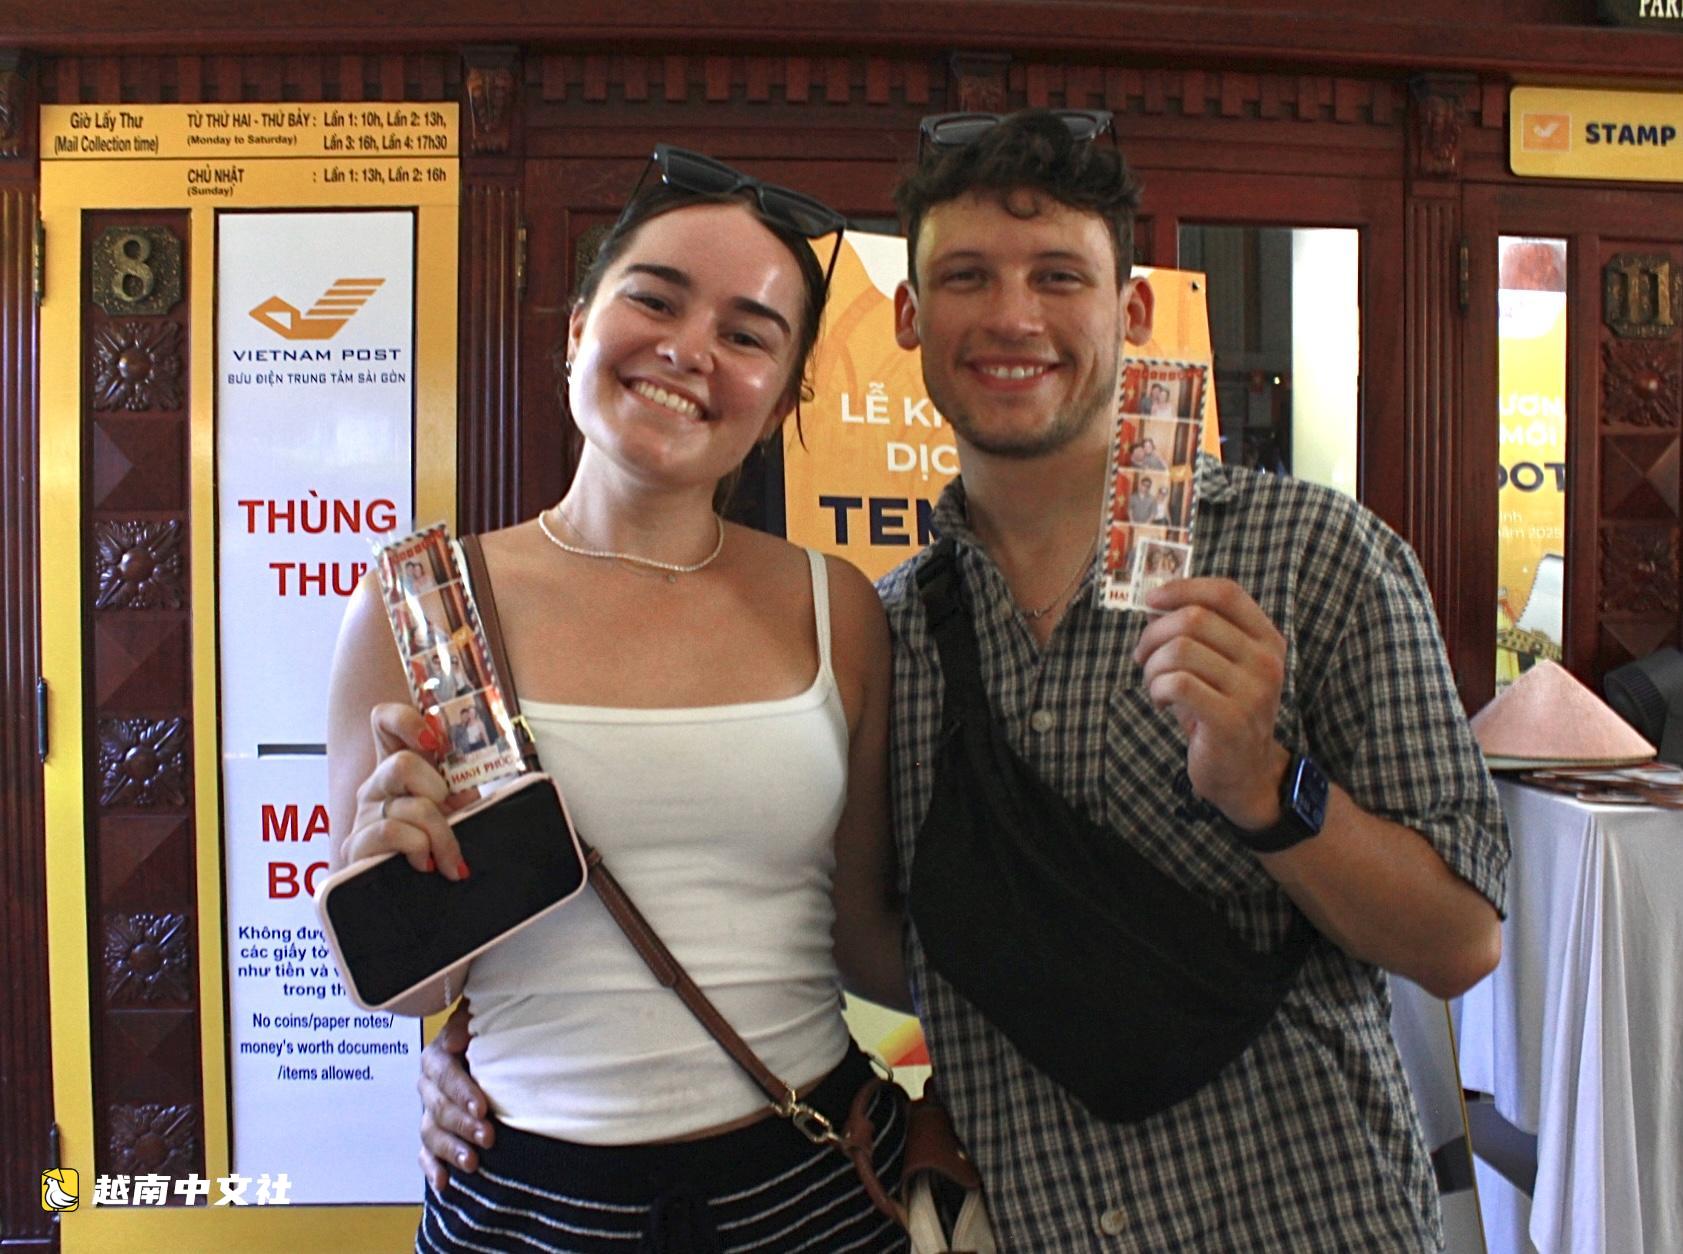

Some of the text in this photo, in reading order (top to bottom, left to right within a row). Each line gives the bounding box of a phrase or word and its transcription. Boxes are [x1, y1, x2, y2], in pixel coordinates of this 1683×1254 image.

[1639, 0, 1683, 18] PAR
[70, 108, 144, 132] Giờ Lấy Thư
[232, 113, 251, 127] HAI
[288, 107, 310, 127] BẢY
[324, 110, 345, 127] Lần
[349, 112, 358, 127] 1:
[361, 112, 384, 129] 10h,
[387, 110, 407, 127] Lần
[410, 112, 420, 127] 2:
[424, 111, 447, 128] 13h,
[187, 134, 297, 147] (Monday to Saturday)
[324, 133, 447, 151] Lần 3: 16h, Lần 4: 17h30
[1585, 122, 1677, 146] STAMP
[55, 136, 159, 155] (Mail Collection time)
[187, 163, 212, 183] CHỦ
[214, 165, 245, 187] NHẬT
[324, 166, 345, 183] Lần
[349, 168, 358, 182] 1:
[362, 168, 385, 183] 13h,
[388, 166, 409, 182] Lần
[412, 168, 422, 182] 2:
[427, 168, 446, 181] 16h
[187, 186, 234, 201] (Sunday)
[112, 233, 153, 301] 8
[233, 349, 401, 361] VIETNAM POST
[227, 369, 406, 387] BƯU ĐIỆN TRUNG TÂM SÀI GÒN
[841, 382, 890, 425] LỄ
[887, 441, 961, 481] DỊC
[238, 489, 397, 534] THÙNG
[269, 562, 367, 597] THƯ
[261, 804, 330, 842] MA
[238, 925, 291, 943] Không
[240, 945, 268, 959] các
[273, 942, 307, 962] giấy
[238, 964, 271, 977] như
[275, 961, 305, 977] tiền
[310, 963, 328, 977] và
[283, 983, 326, 999] trong
[253, 1013, 394, 1031] No coins/paper notes/
[240, 1039, 409, 1057] money's worth documents
[277, 1065, 374, 1080] /items allowed.
